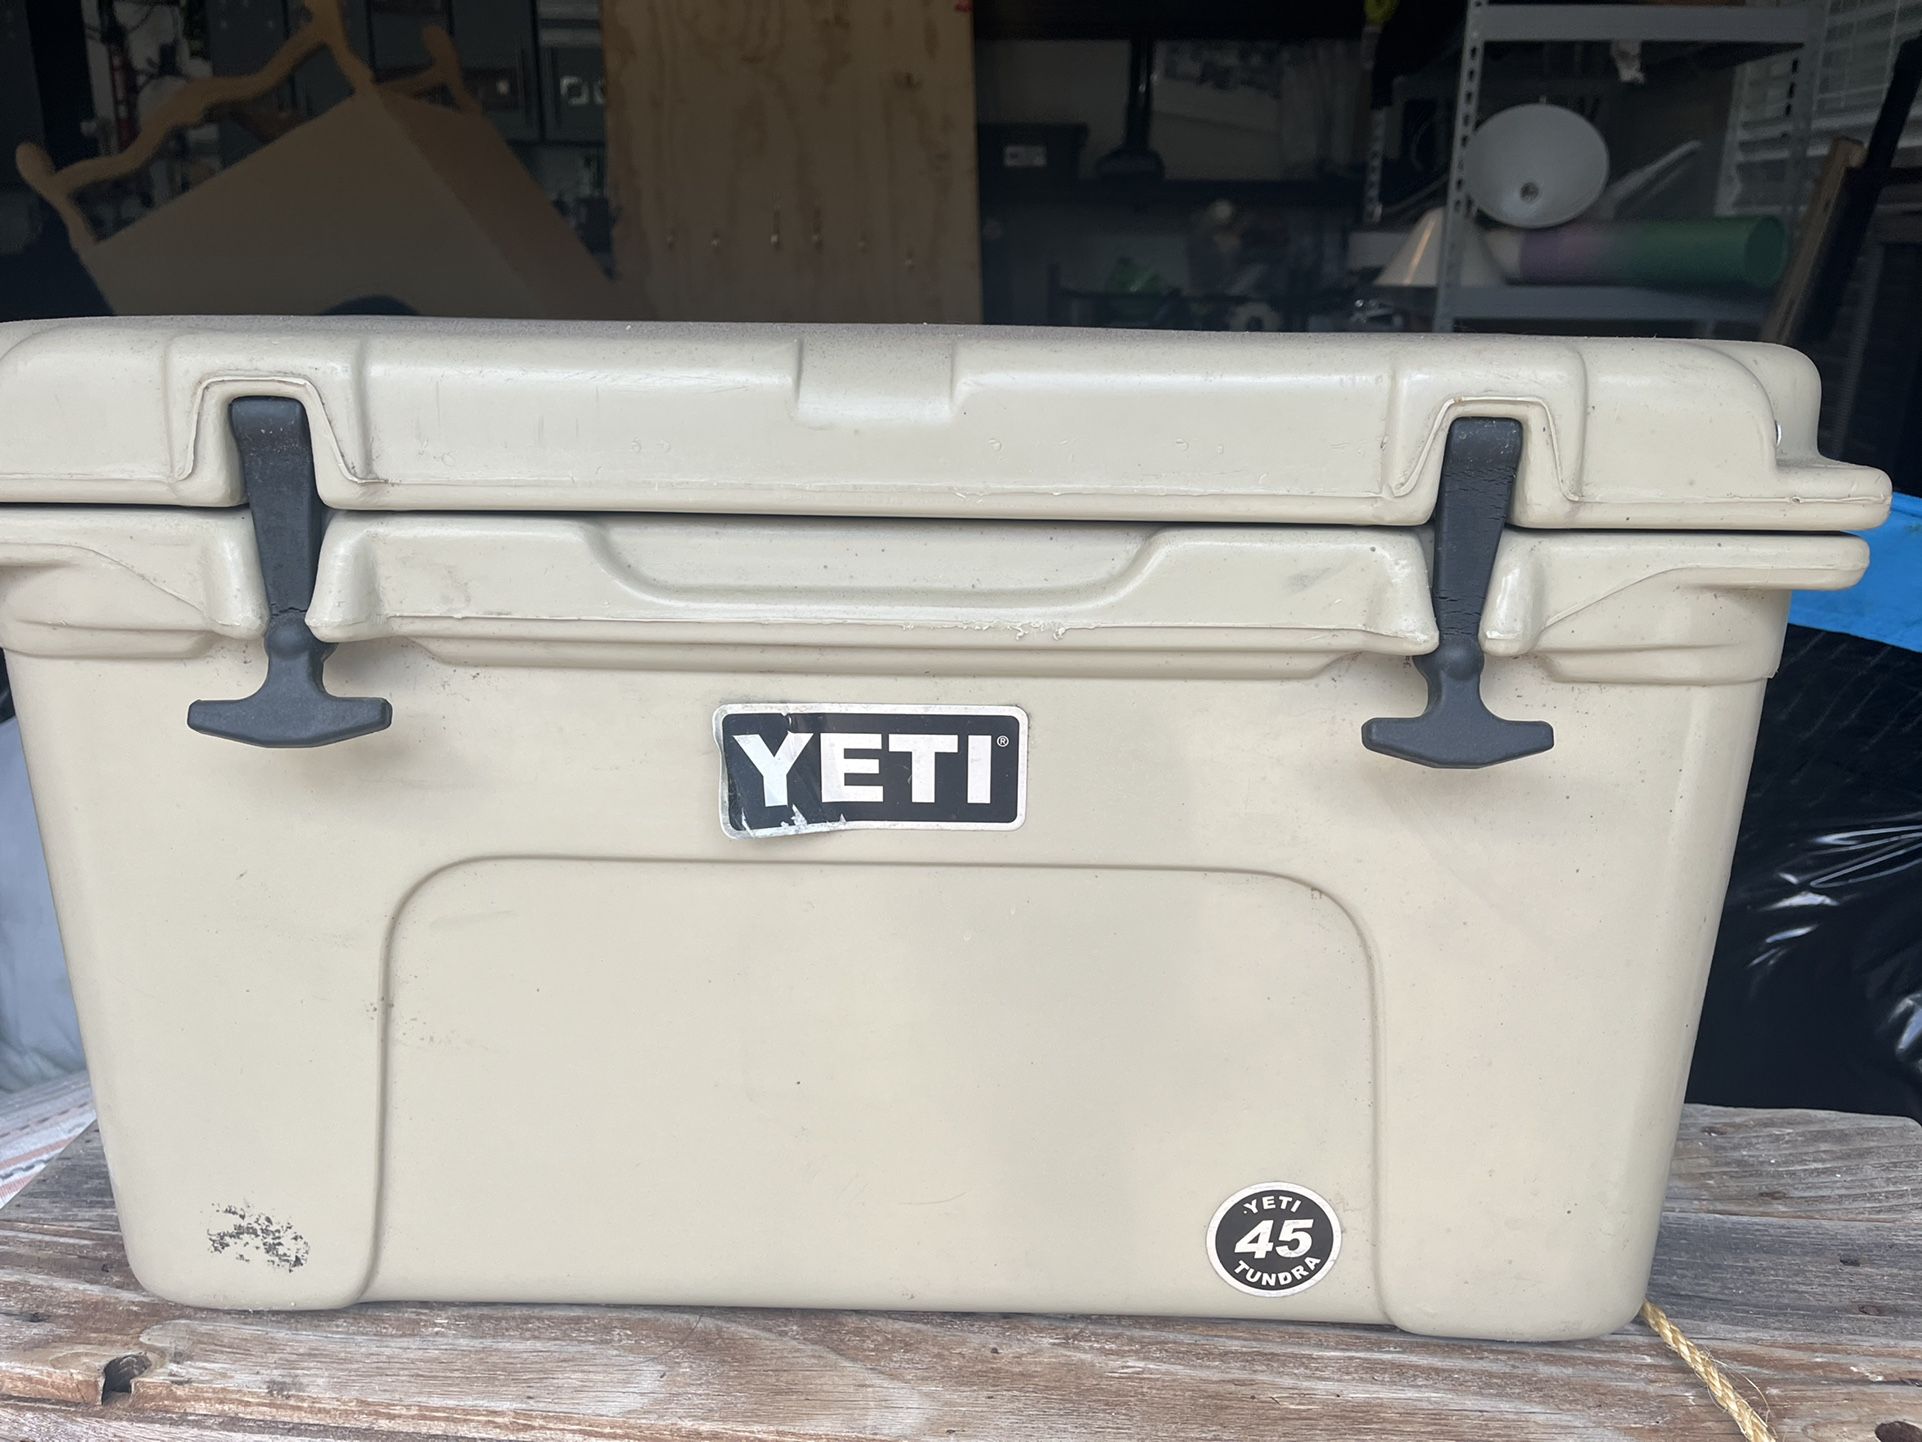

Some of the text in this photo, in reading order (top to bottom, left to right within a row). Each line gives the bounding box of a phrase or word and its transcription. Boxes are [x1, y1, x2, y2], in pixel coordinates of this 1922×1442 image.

[1243, 1195, 1302, 1214] YETI
[1234, 1218, 1314, 1259] 45
[1234, 1256, 1321, 1286] TUNDRA
